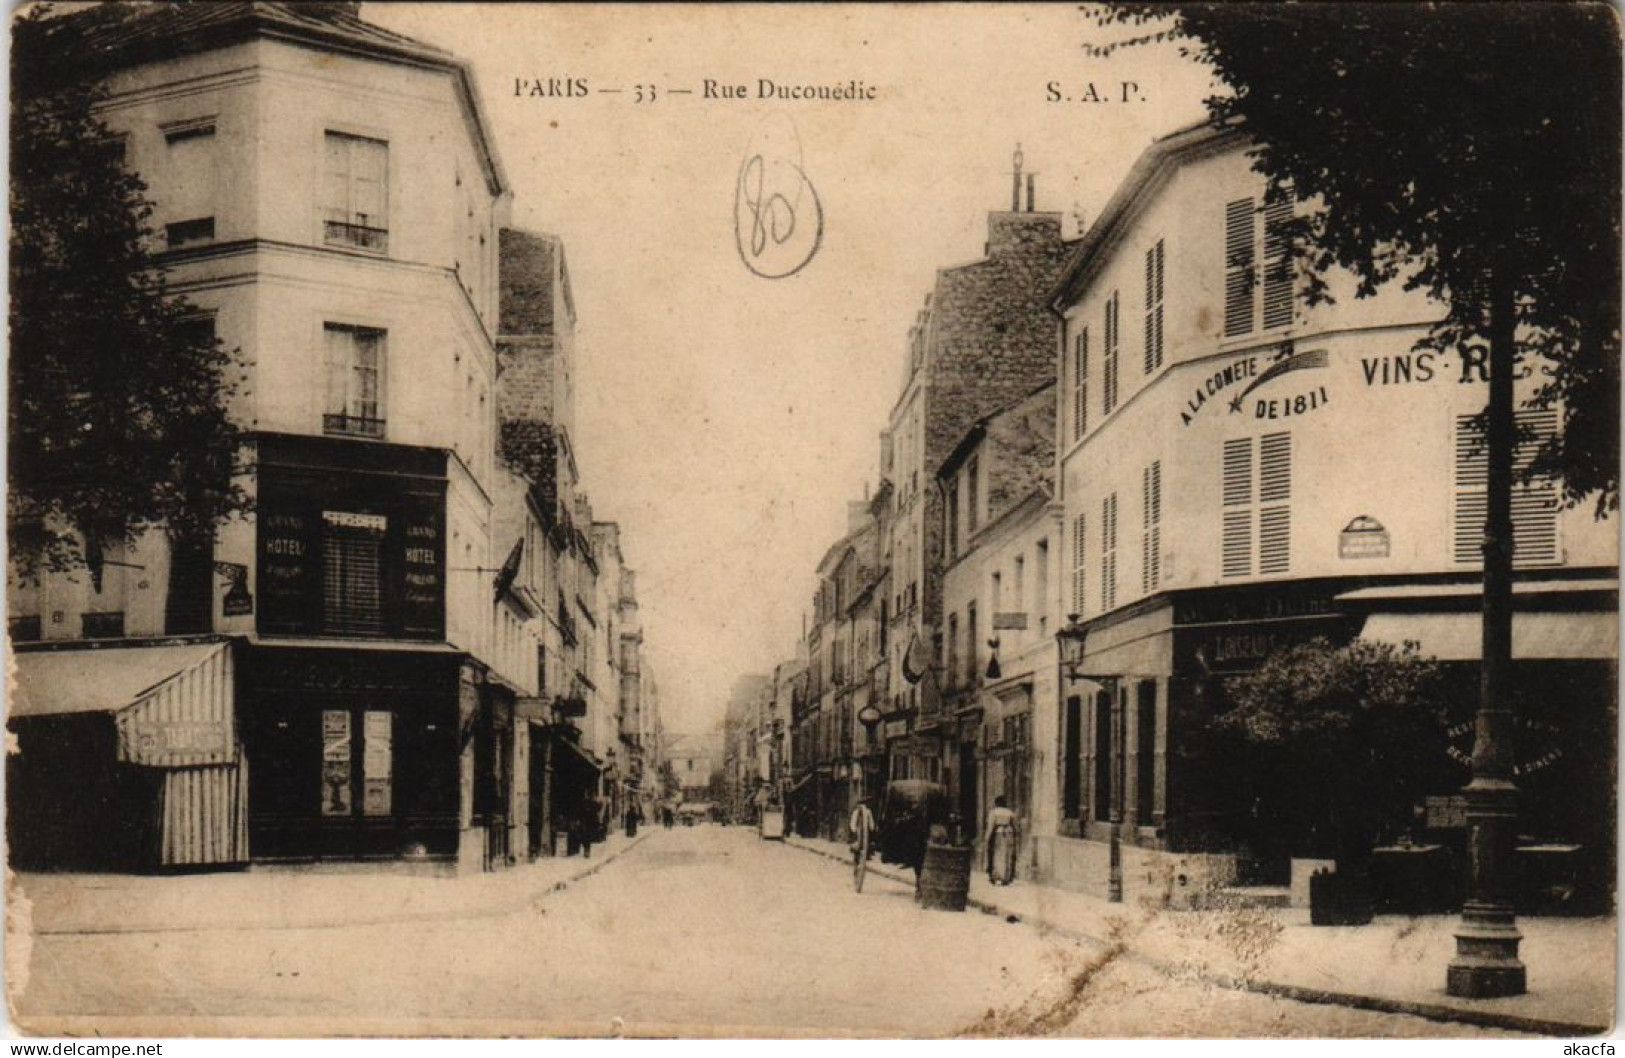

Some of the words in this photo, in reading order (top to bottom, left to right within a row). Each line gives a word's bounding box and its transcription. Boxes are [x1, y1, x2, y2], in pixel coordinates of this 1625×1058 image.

[1180, 411, 1192, 426] A
[1188, 389, 1206, 413] LA
[1205, 357, 1258, 397] COMETE
[1255, 400, 1279, 420] DE
[1283, 386, 1329, 417] 1811
[266, 538, 304, 556] HOTEL
[405, 547, 437, 565] HOTEL
